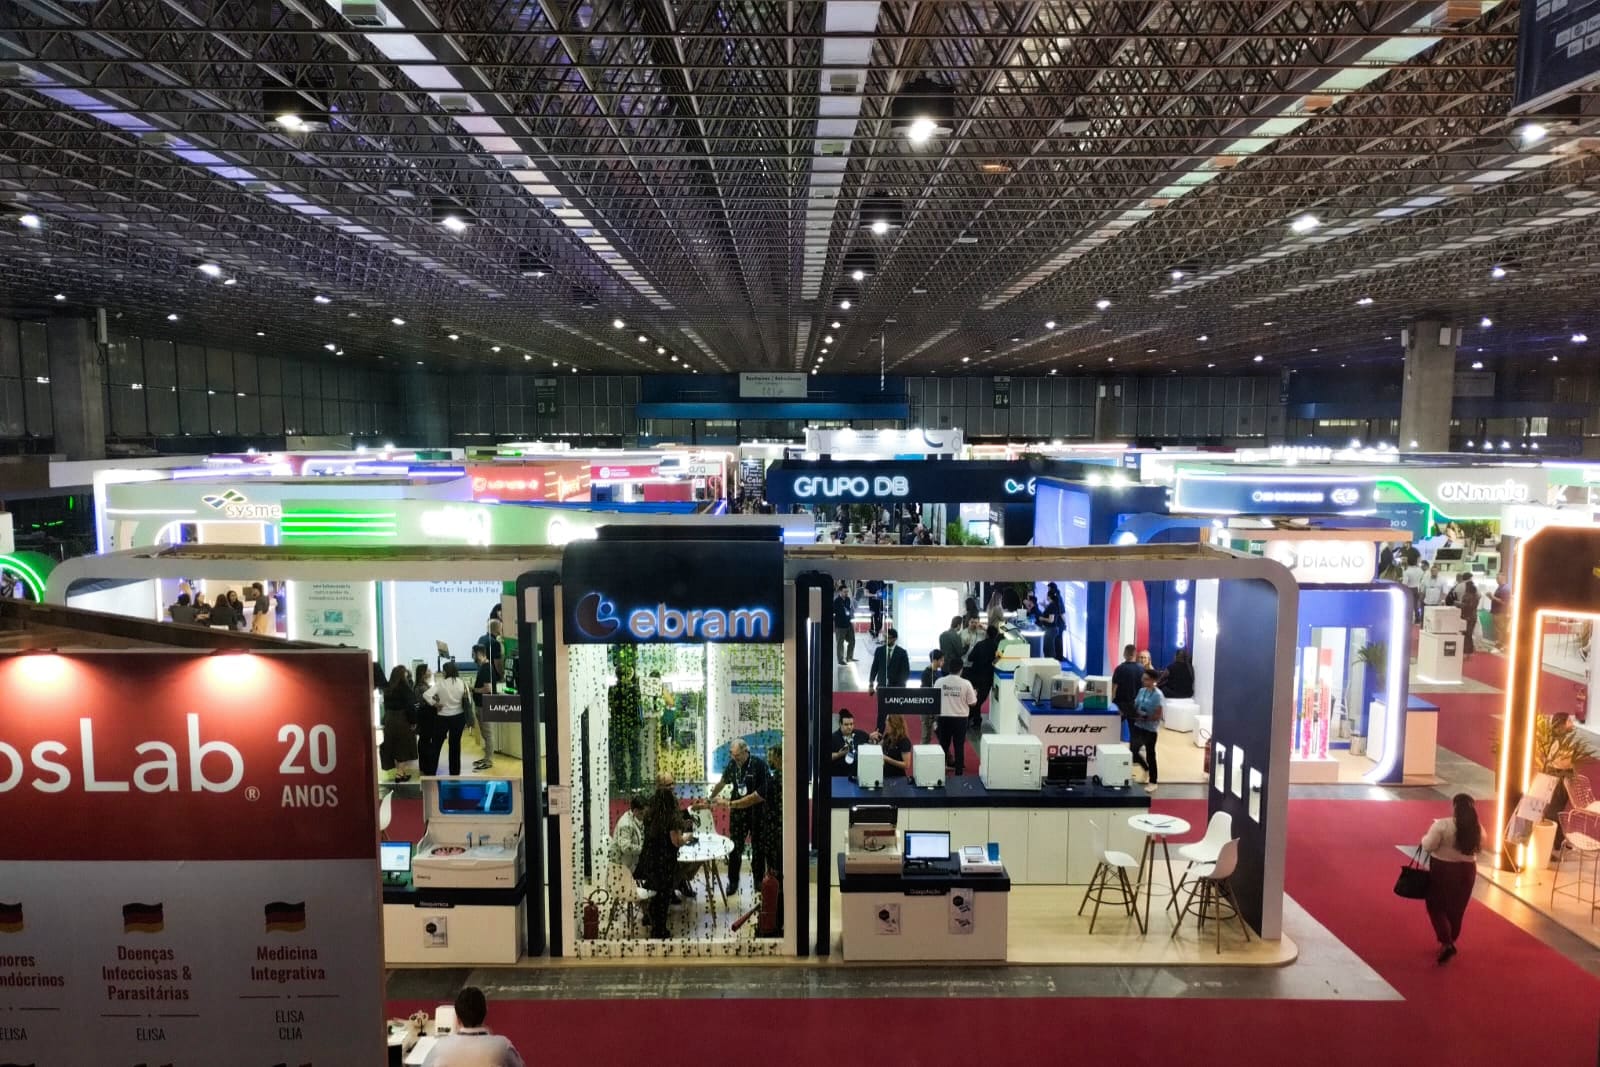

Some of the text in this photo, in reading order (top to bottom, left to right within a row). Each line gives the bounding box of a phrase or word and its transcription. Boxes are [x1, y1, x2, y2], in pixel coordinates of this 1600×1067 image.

[874, 475, 910, 497] DB
[1302, 554, 1365, 568] DIAGNO
[628, 604, 771, 639] ebram
[884, 697, 934, 706] LANÇAMENTO
[278, 724, 337, 774] 20
[281, 785, 339, 808] ANOS
[117, 945, 175, 964] Doenças
[257, 946, 318, 961] Medicina
[102, 966, 193, 981] Infecciosas &
[251, 966, 326, 983] Integrativa
[108, 985, 190, 1001] Parasitárias
[275, 1009, 305, 1024] ELISA
[136, 1027, 166, 1042] ELISA
[279, 1027, 303, 1041] CLIA
